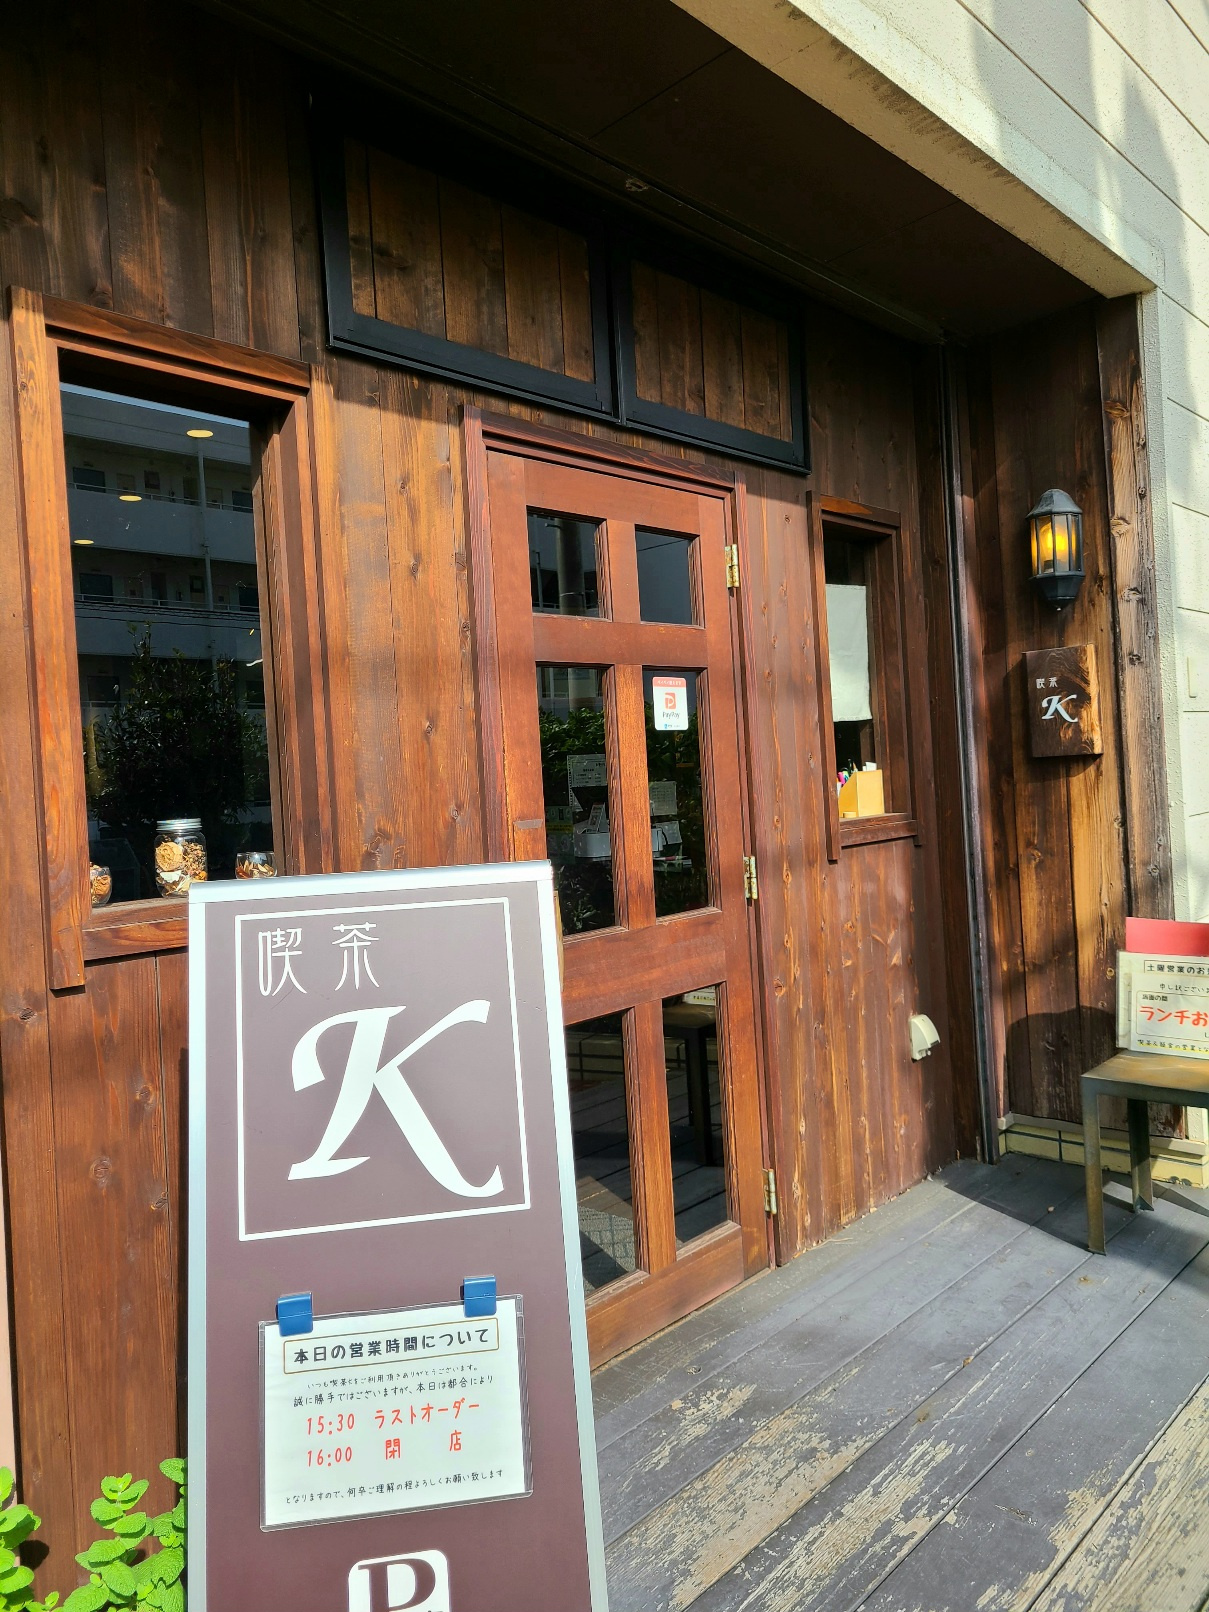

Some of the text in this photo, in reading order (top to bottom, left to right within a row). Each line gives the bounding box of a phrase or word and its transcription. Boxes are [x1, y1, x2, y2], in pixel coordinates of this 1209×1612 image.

[662, 711, 681, 720] PayPay
[1041, 694, 1078, 723] K
[257, 921, 380, 997] 喫茶
[1146, 963, 1209, 975] 土曜営業のお
[1139, 1006, 1208, 1027] ランチお
[287, 999, 505, 1198] K
[293, 1328, 490, 1364] 本日の営業時間について
[306, 1397, 480, 1435] 15:30 ラストオーダー
[307, 1446, 353, 1467] 16:00
